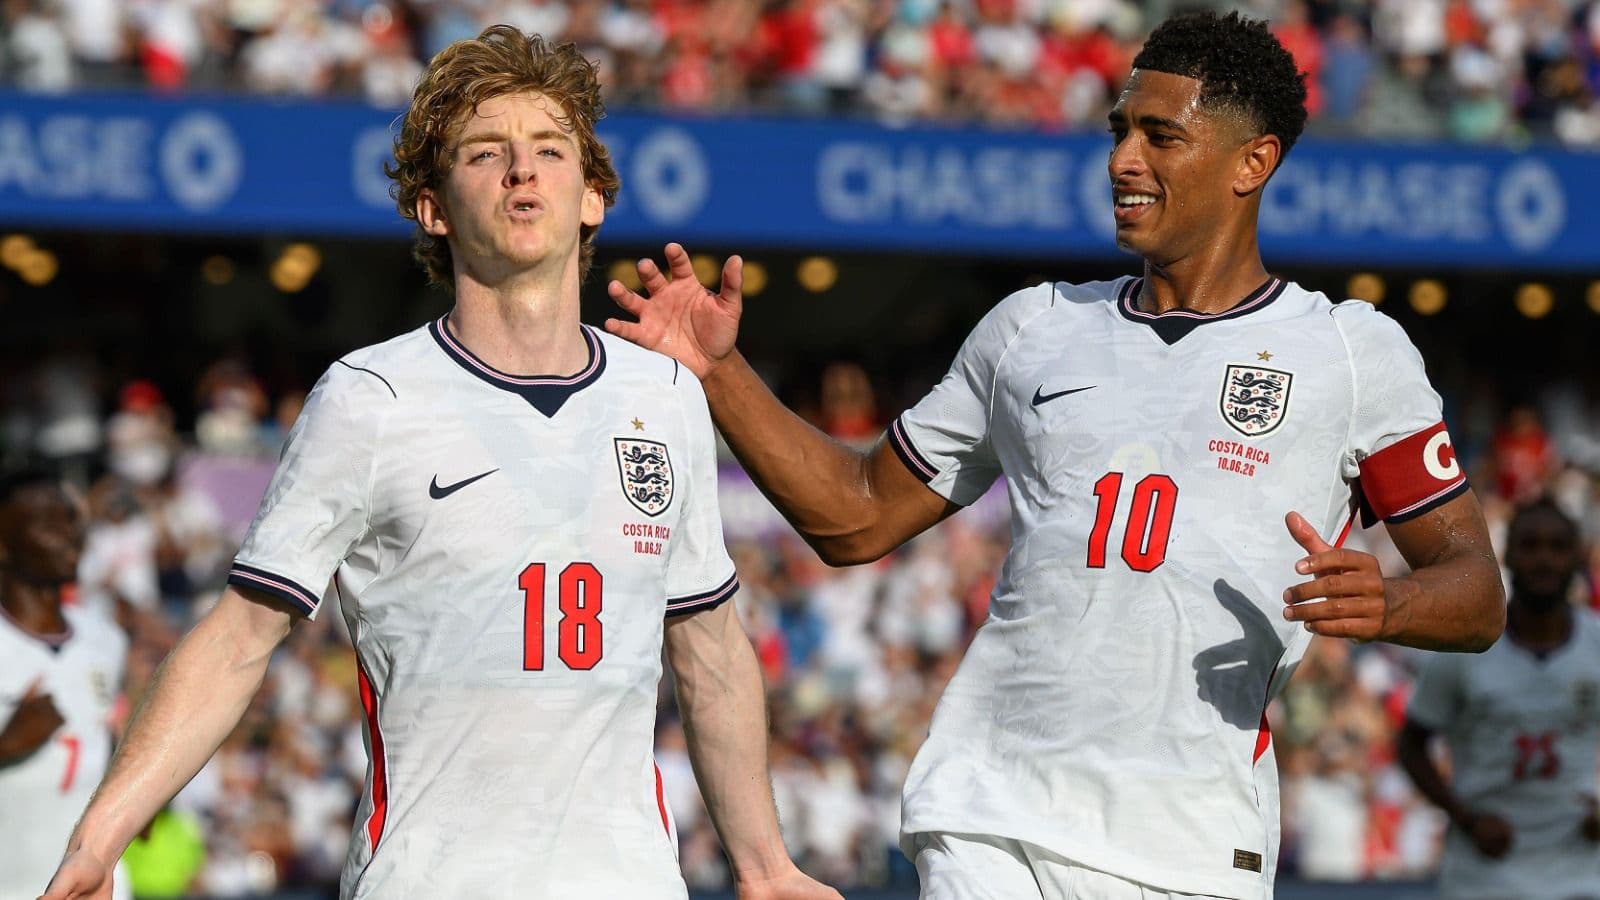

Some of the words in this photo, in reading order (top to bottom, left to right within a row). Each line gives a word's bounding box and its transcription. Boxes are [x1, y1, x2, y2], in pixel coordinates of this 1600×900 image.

[818, 142, 1074, 227] CHASE
[1257, 159, 1491, 240] CHASE
[1208, 439, 1244, 457] COSTA
[1245, 446, 1270, 465] RICA
[1217, 456, 1255, 477] 10.06.26
[1423, 430, 1460, 480] C
[622, 523, 653, 538] COSTA
[1087, 472, 1178, 572] 10
[519, 562, 603, 670] 18
[59, 735, 80, 793] 7
